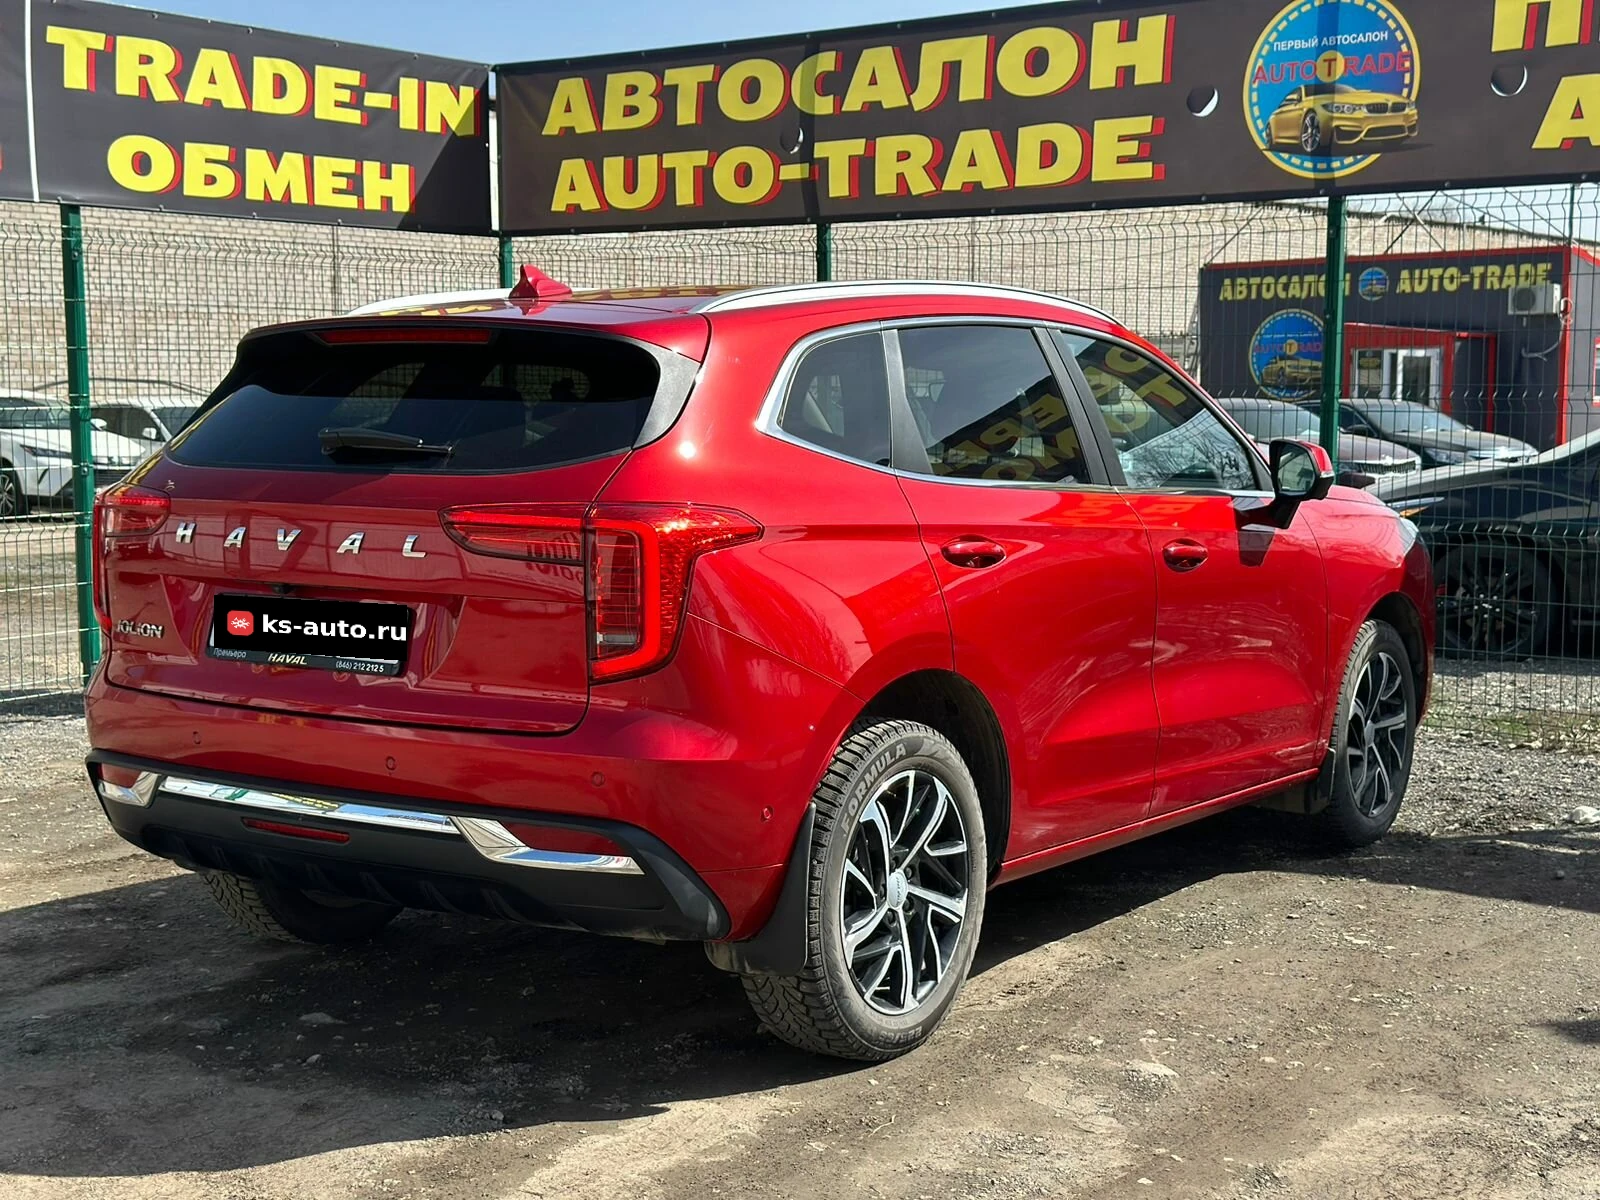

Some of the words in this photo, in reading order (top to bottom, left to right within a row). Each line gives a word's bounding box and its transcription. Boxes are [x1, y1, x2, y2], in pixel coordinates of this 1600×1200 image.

[542, 13, 1175, 136] АВТОСАЛОН
[1273, 36, 1318, 51] ПЕРВЫЙ
[1321, 30, 1388, 47] АВТОСАЛОН
[46, 25, 480, 136] TRADE-IN
[107, 134, 415, 213] ОБМЕН
[550, 115, 1165, 213] AUTO-TRADE
[1396, 262, 1553, 294] AUTO-TRADE
[174, 522, 428, 558] HAVAL
[267, 652, 308, 665] HAVAL
[841, 743, 907, 834] FORMULA
